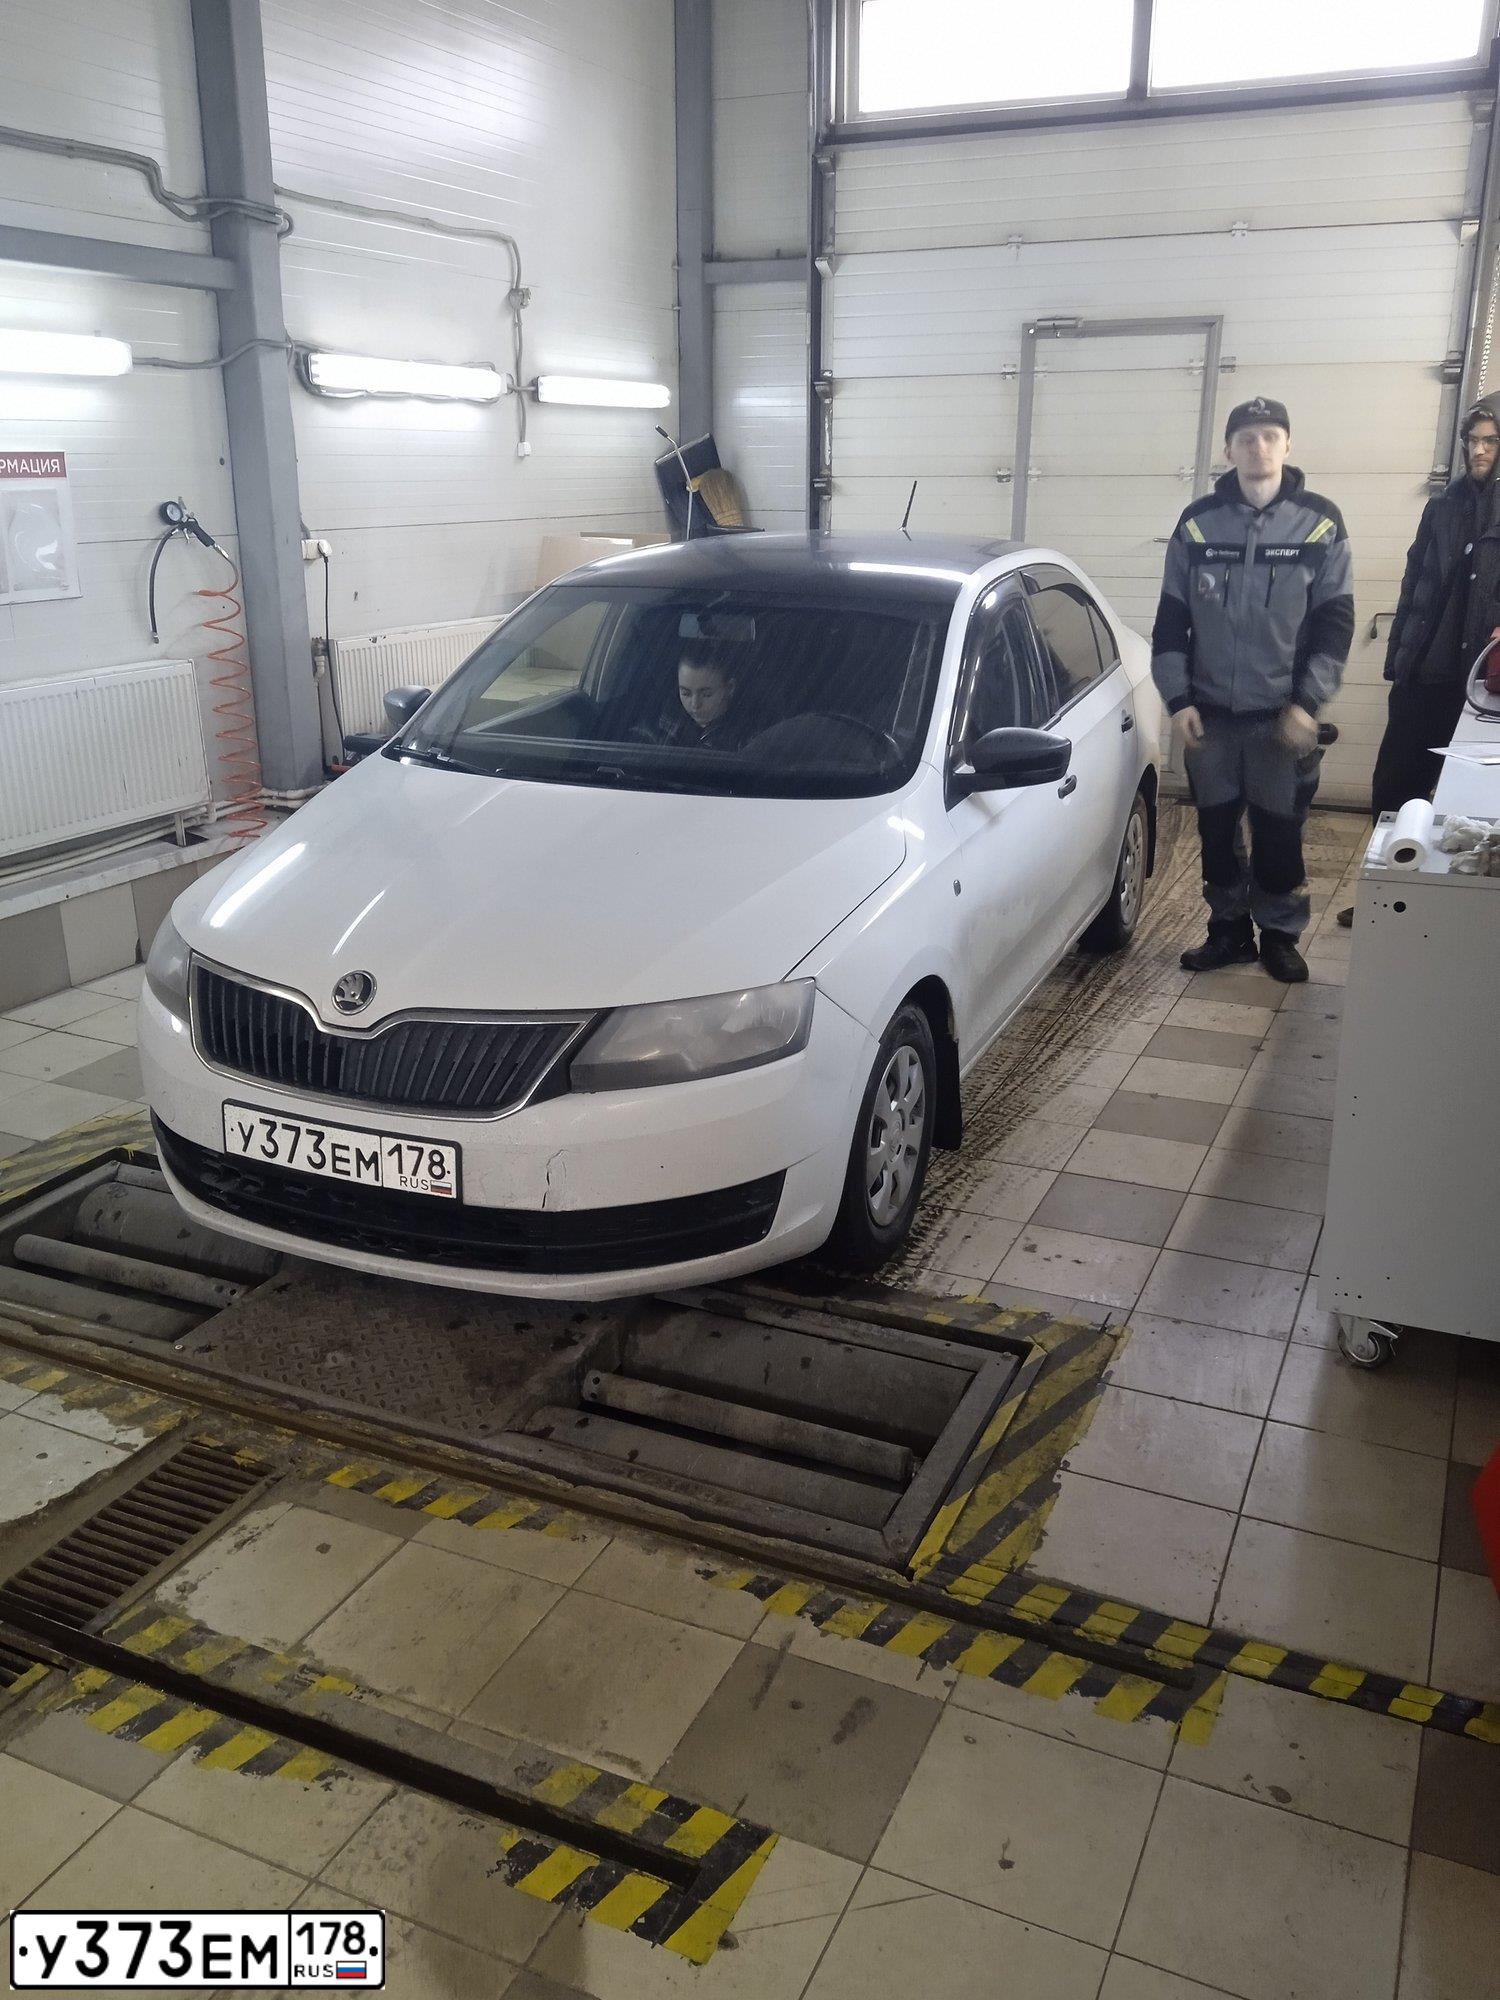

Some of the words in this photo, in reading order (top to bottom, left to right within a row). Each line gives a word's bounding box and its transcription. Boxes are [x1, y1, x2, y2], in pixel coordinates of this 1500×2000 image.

[0, 458, 61, 475] РМАЦИЯ
[1265, 548, 1300, 557] ЭКСПЕРТ
[388, 1143, 447, 1180] 178
[399, 1176, 429, 1191] RUS
